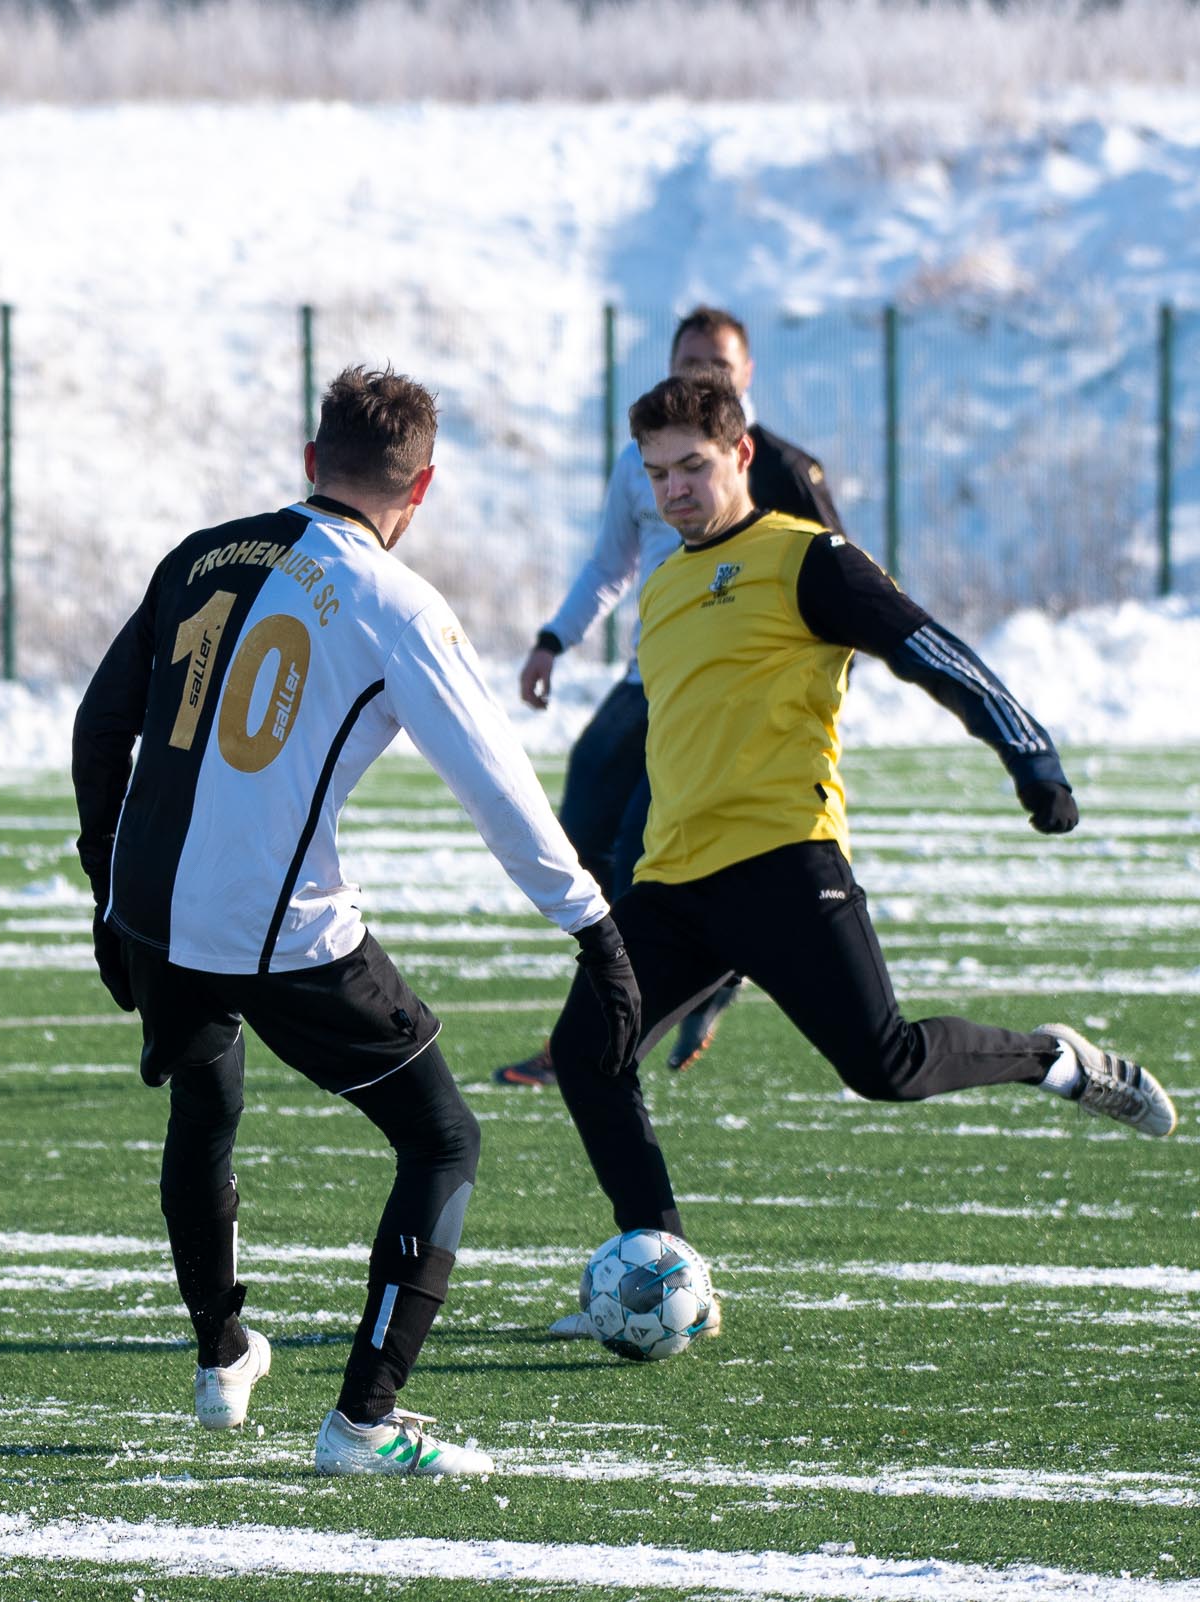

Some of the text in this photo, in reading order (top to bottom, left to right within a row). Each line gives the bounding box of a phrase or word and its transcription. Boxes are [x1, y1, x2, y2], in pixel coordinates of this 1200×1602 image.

[187, 541, 339, 627] FROHENAUER SC
[168, 590, 311, 773] 10
[189, 630, 214, 708] saller
[272, 662, 303, 742] saller
[820, 890, 846, 899] JAKO
